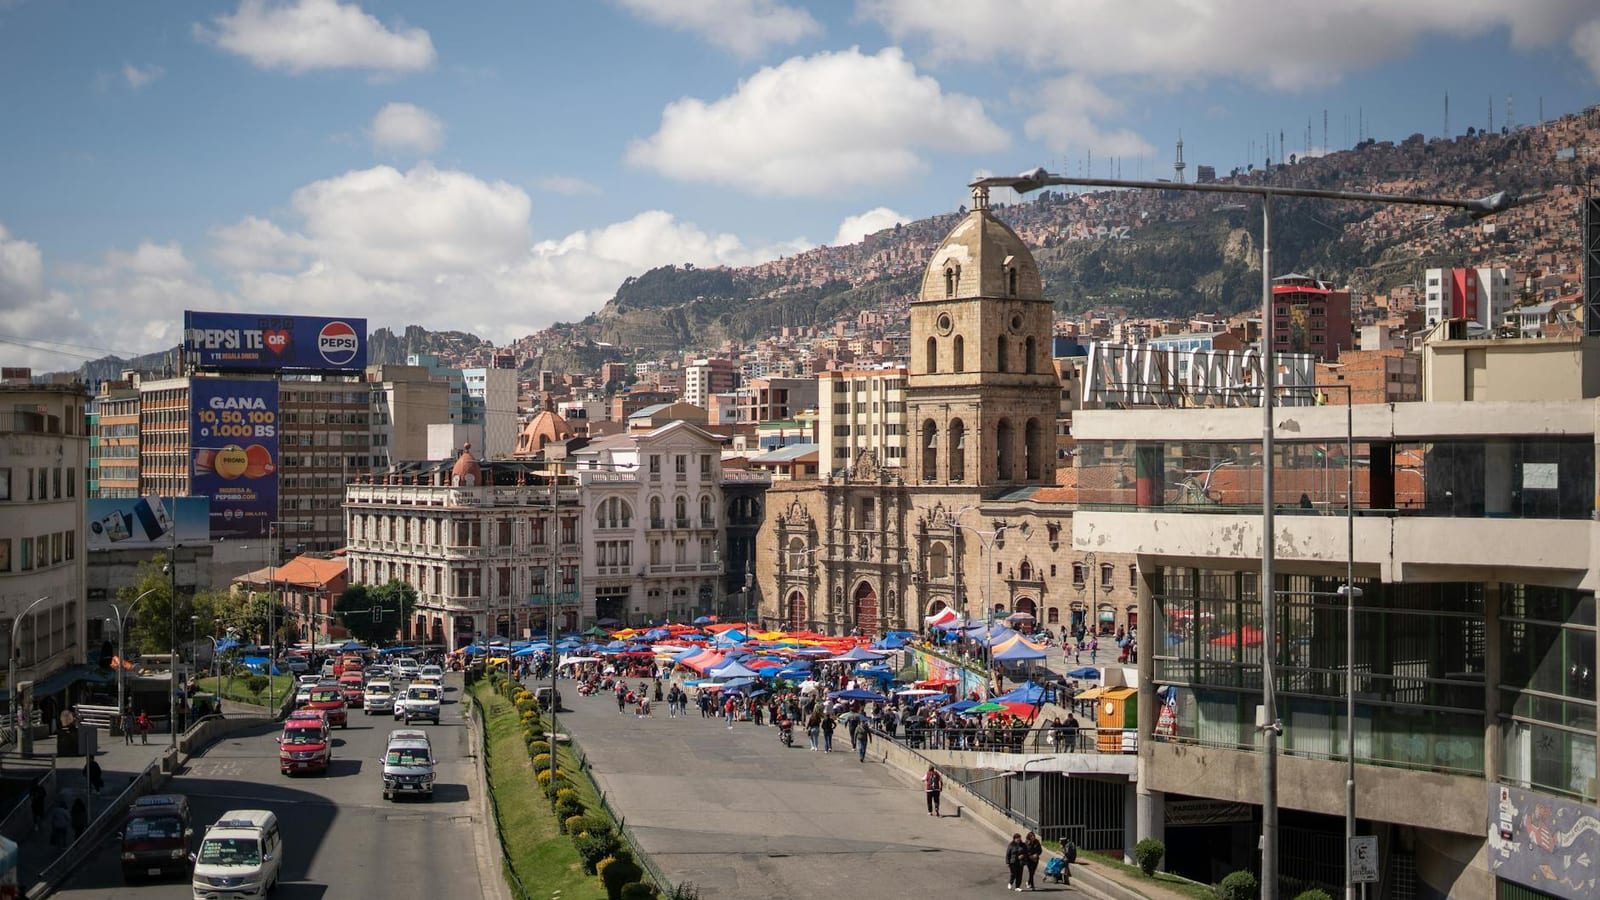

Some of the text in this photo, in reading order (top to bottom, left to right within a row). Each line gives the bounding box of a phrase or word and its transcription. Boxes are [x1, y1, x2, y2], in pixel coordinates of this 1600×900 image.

[1097, 225, 1130, 240] PAZ
[193, 329, 240, 349] PEPSI
[244, 330, 263, 349] TE
[321, 338, 356, 348] PEPSI
[209, 396, 266, 409] GANA
[199, 410, 275, 425] 10, 50, 100
[211, 424, 252, 437] 1.000
[255, 425, 275, 437] BS
